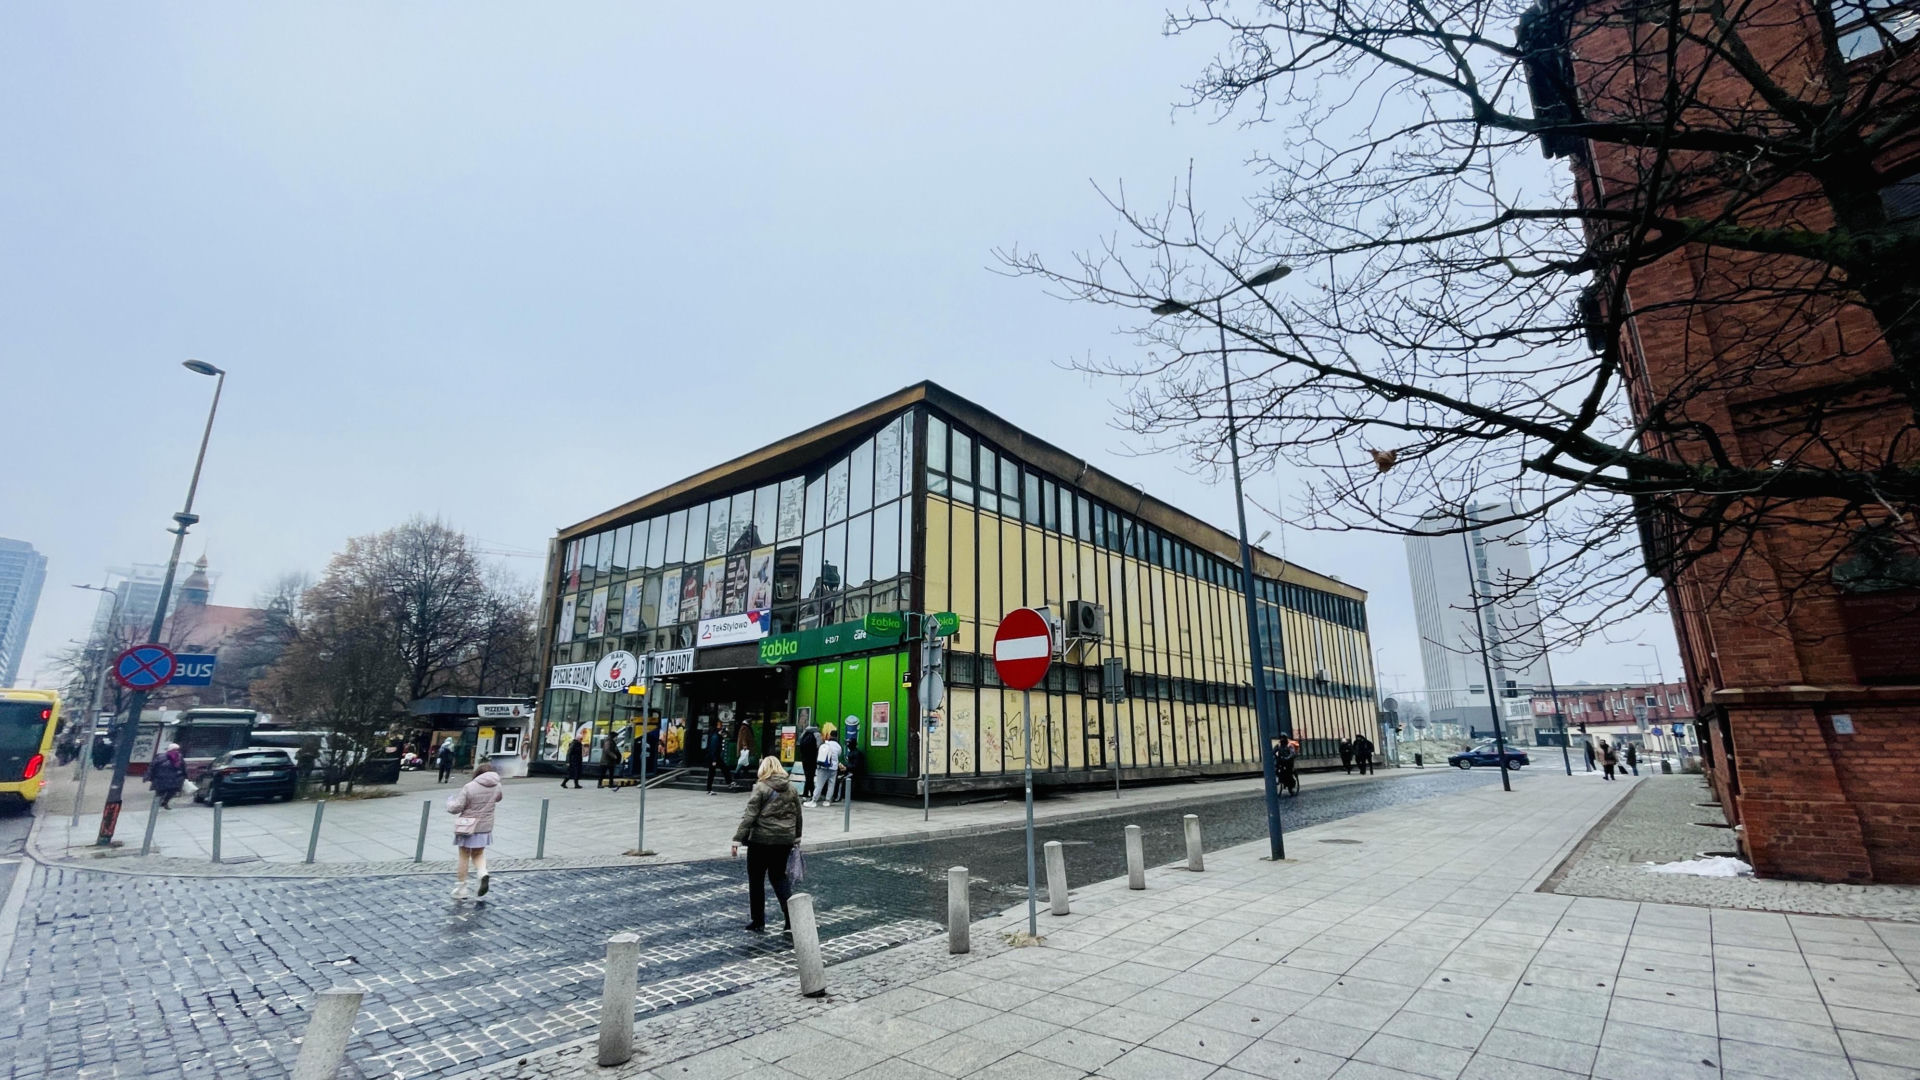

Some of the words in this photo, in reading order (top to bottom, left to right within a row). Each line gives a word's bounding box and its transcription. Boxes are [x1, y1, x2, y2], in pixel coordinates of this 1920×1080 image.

[712, 621, 748, 632] TekStylowo
[871, 616, 900, 628] żabka
[761, 638, 798, 658] żabka
[666, 653, 691, 673] OBIADY
[173, 663, 213, 677] BUS
[603, 678, 627, 689] GUCIO
